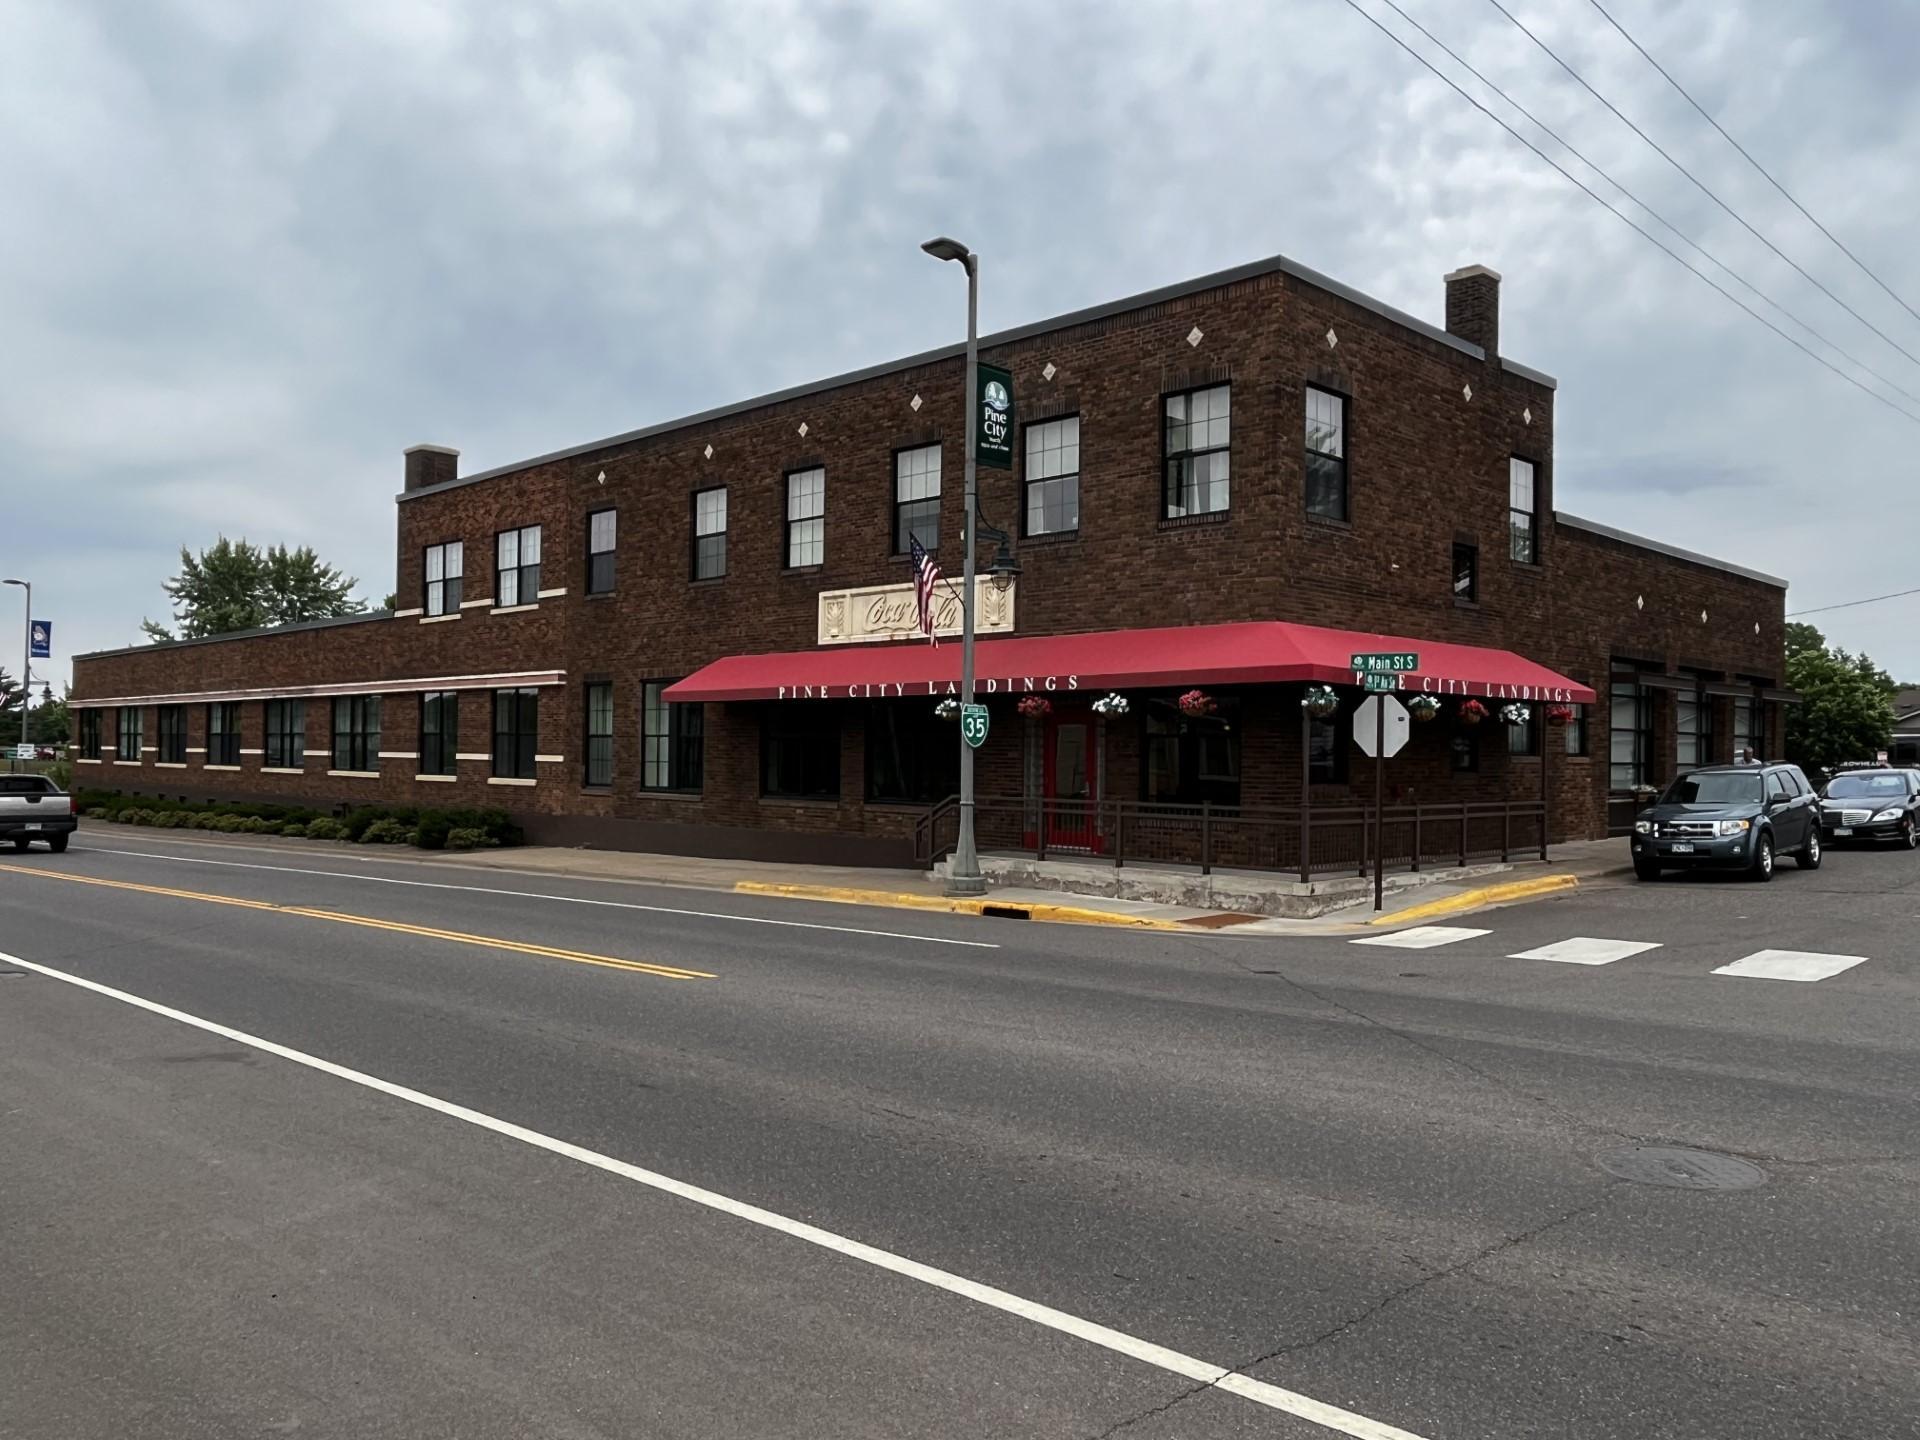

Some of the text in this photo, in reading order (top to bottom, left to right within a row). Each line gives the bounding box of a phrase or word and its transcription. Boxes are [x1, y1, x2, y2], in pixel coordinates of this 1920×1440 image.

[984, 406, 1007, 424] Pine
[984, 421, 1007, 440] City
[864, 592, 962, 633] Coca-Cla
[1368, 655, 1413, 669] Main St S
[778, 675, 1078, 699] PINE CITY LADINGS
[1356, 671, 1572, 702] PE CITY LANDINGS
[966, 718, 985, 737] 35
